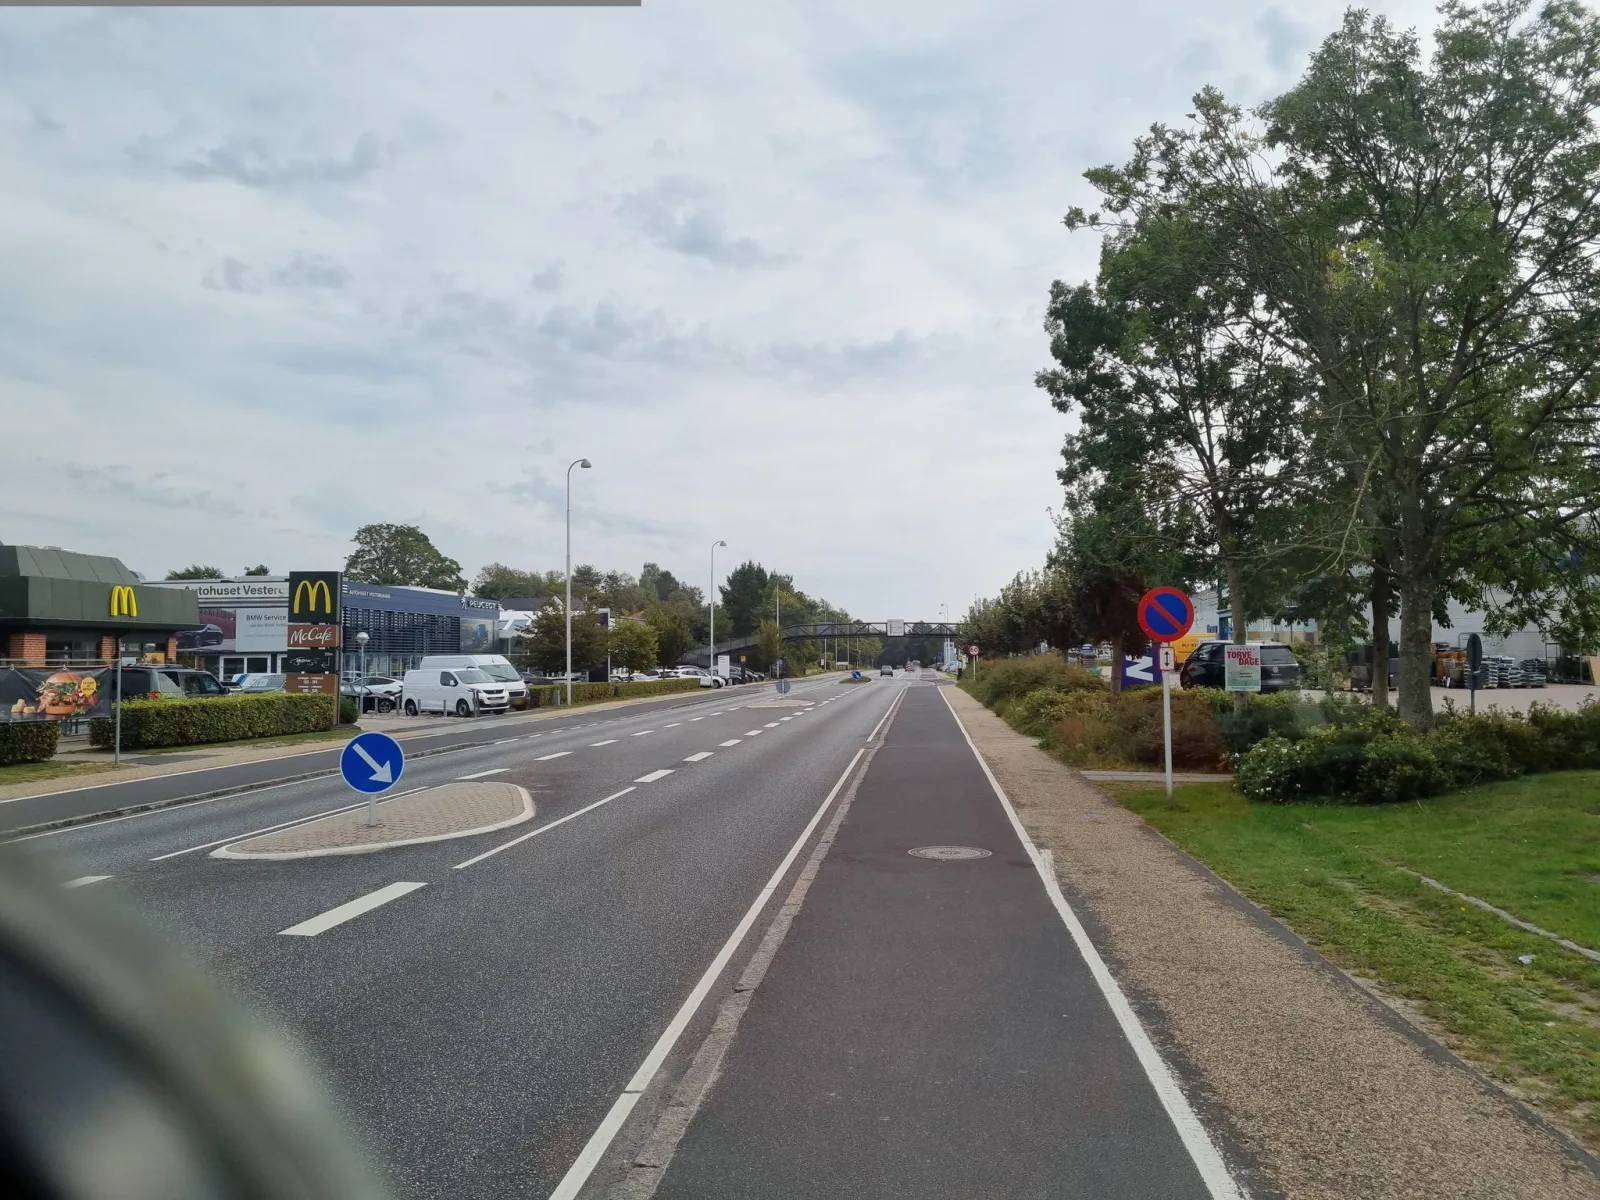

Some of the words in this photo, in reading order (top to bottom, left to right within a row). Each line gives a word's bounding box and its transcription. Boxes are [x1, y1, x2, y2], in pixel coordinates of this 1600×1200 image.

[470, 600, 496, 610] PEUGEOT
[290, 627, 332, 645] McCafé
[1227, 651, 1252, 659] TORVE
[1238, 658, 1260, 666] DAGE
